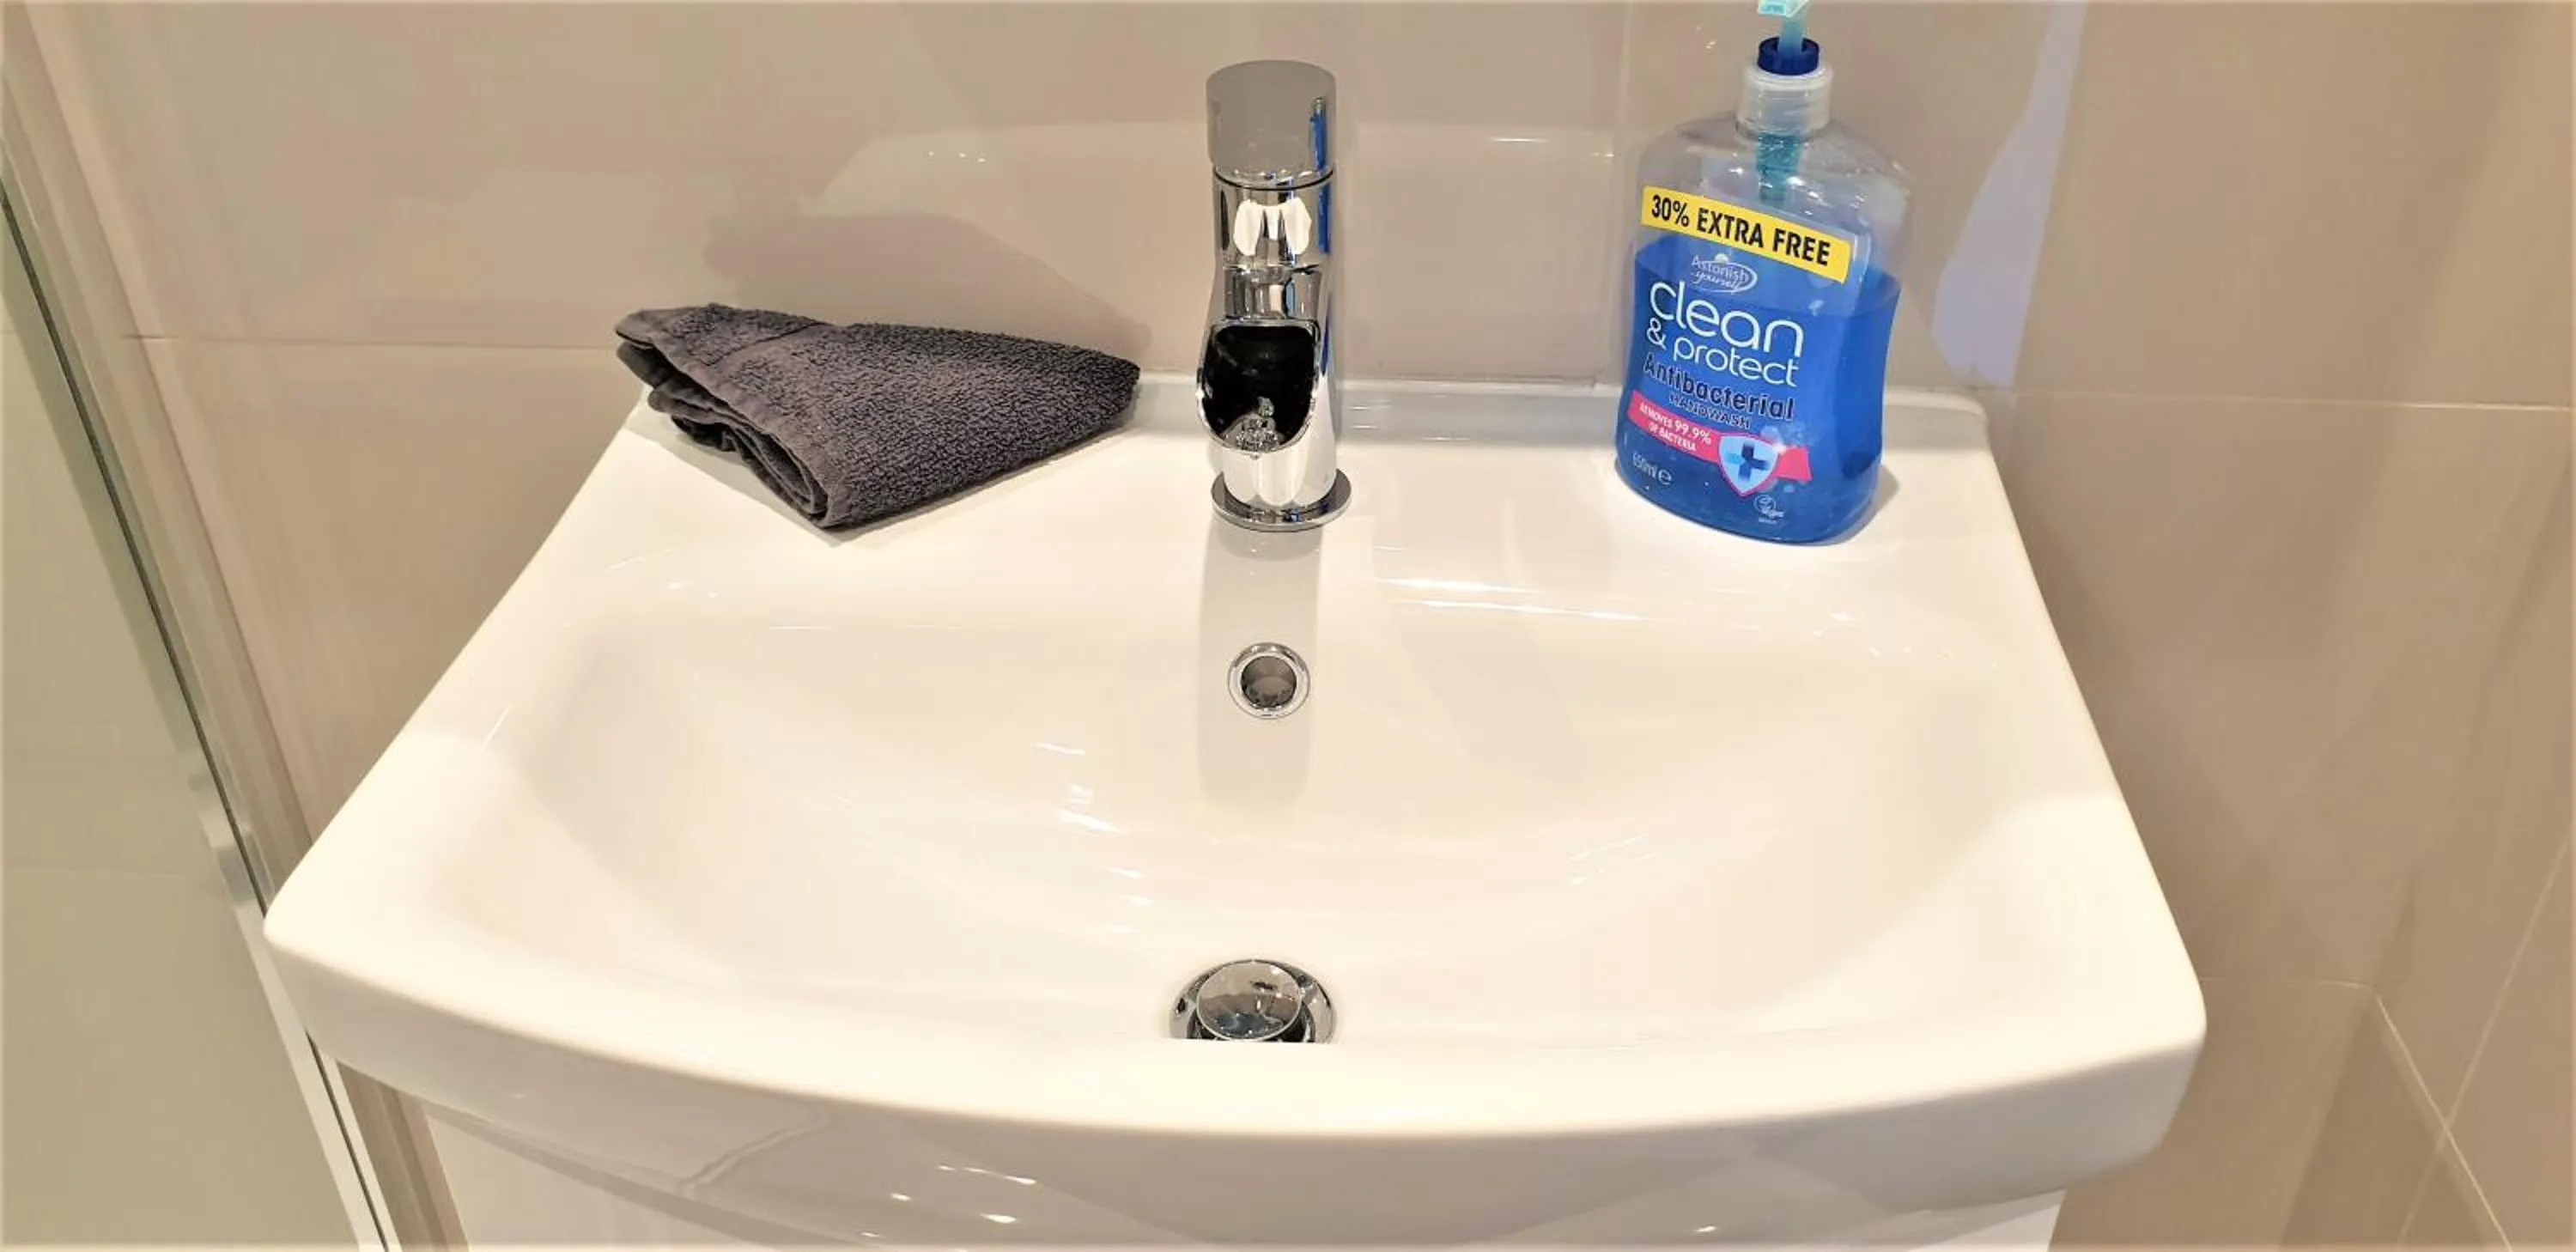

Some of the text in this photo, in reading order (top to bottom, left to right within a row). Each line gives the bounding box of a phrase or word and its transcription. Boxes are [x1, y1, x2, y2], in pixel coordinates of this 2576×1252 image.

[1651, 195, 1831, 266] 30% EXTRA FREE
[1691, 255, 1749, 282] Astonish
[1650, 281, 1803, 357] clean
[1647, 318, 1799, 387] & protect
[1643, 351, 1795, 420] Antibacterial
[1668, 392, 1752, 429] HANDWASH
[1658, 427, 1697, 452] BACTERIA
[1674, 418, 1712, 445] 99.9%
